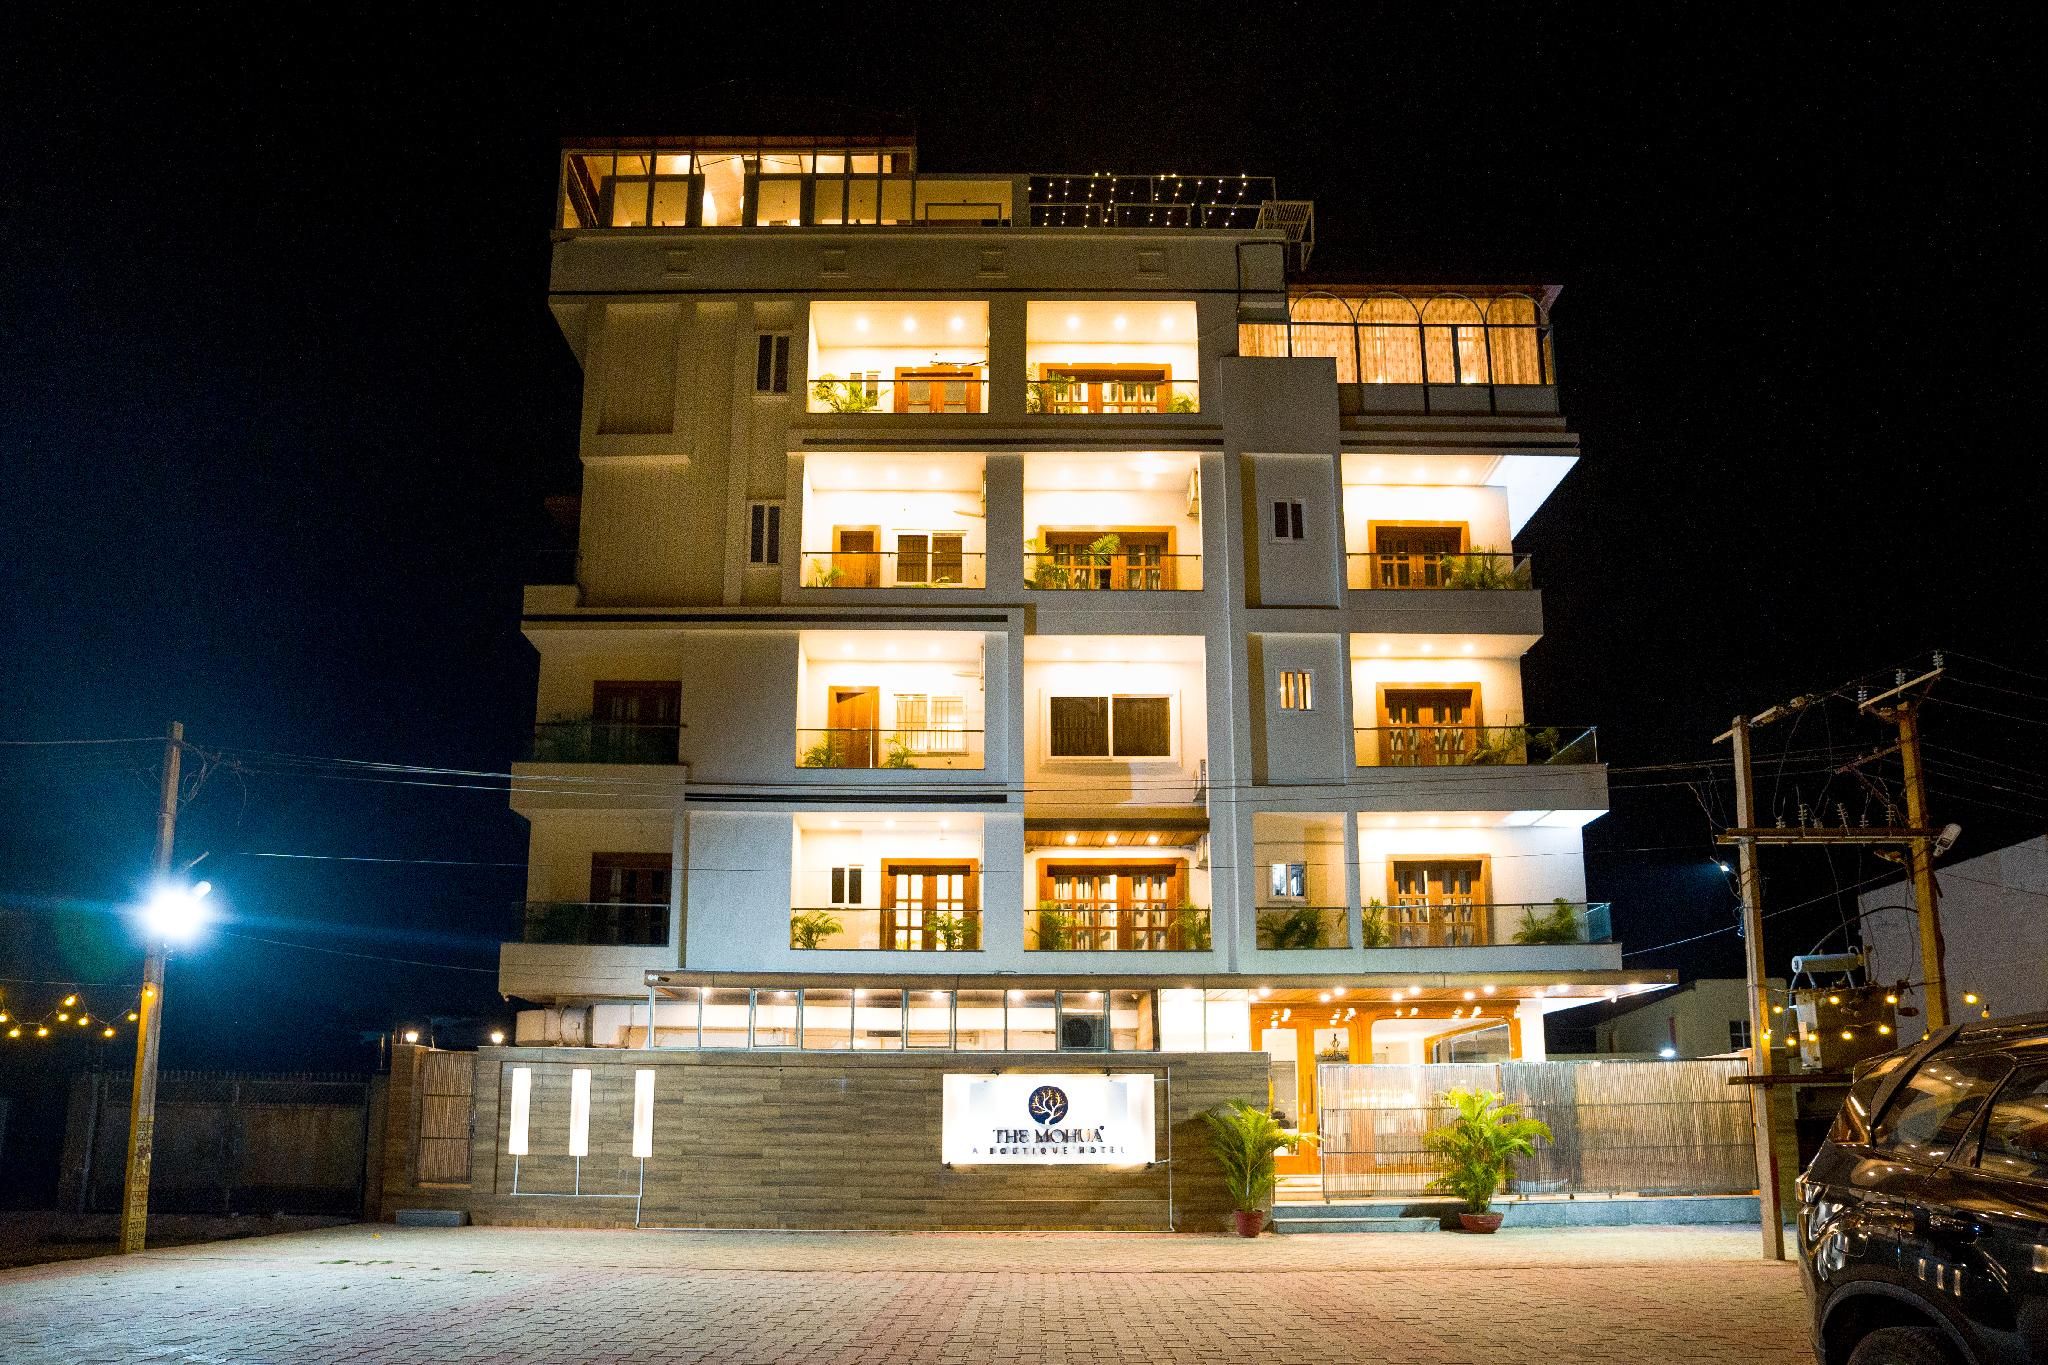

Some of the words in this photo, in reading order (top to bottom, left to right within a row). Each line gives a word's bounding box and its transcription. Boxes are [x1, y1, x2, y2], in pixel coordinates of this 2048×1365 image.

[993, 1129, 1029, 1143] THE
[1034, 1128, 1103, 1143] MOHUA
[989, 1147, 1068, 1155] BOUTIQUE
[1078, 1146, 1124, 1154] HOTEL
